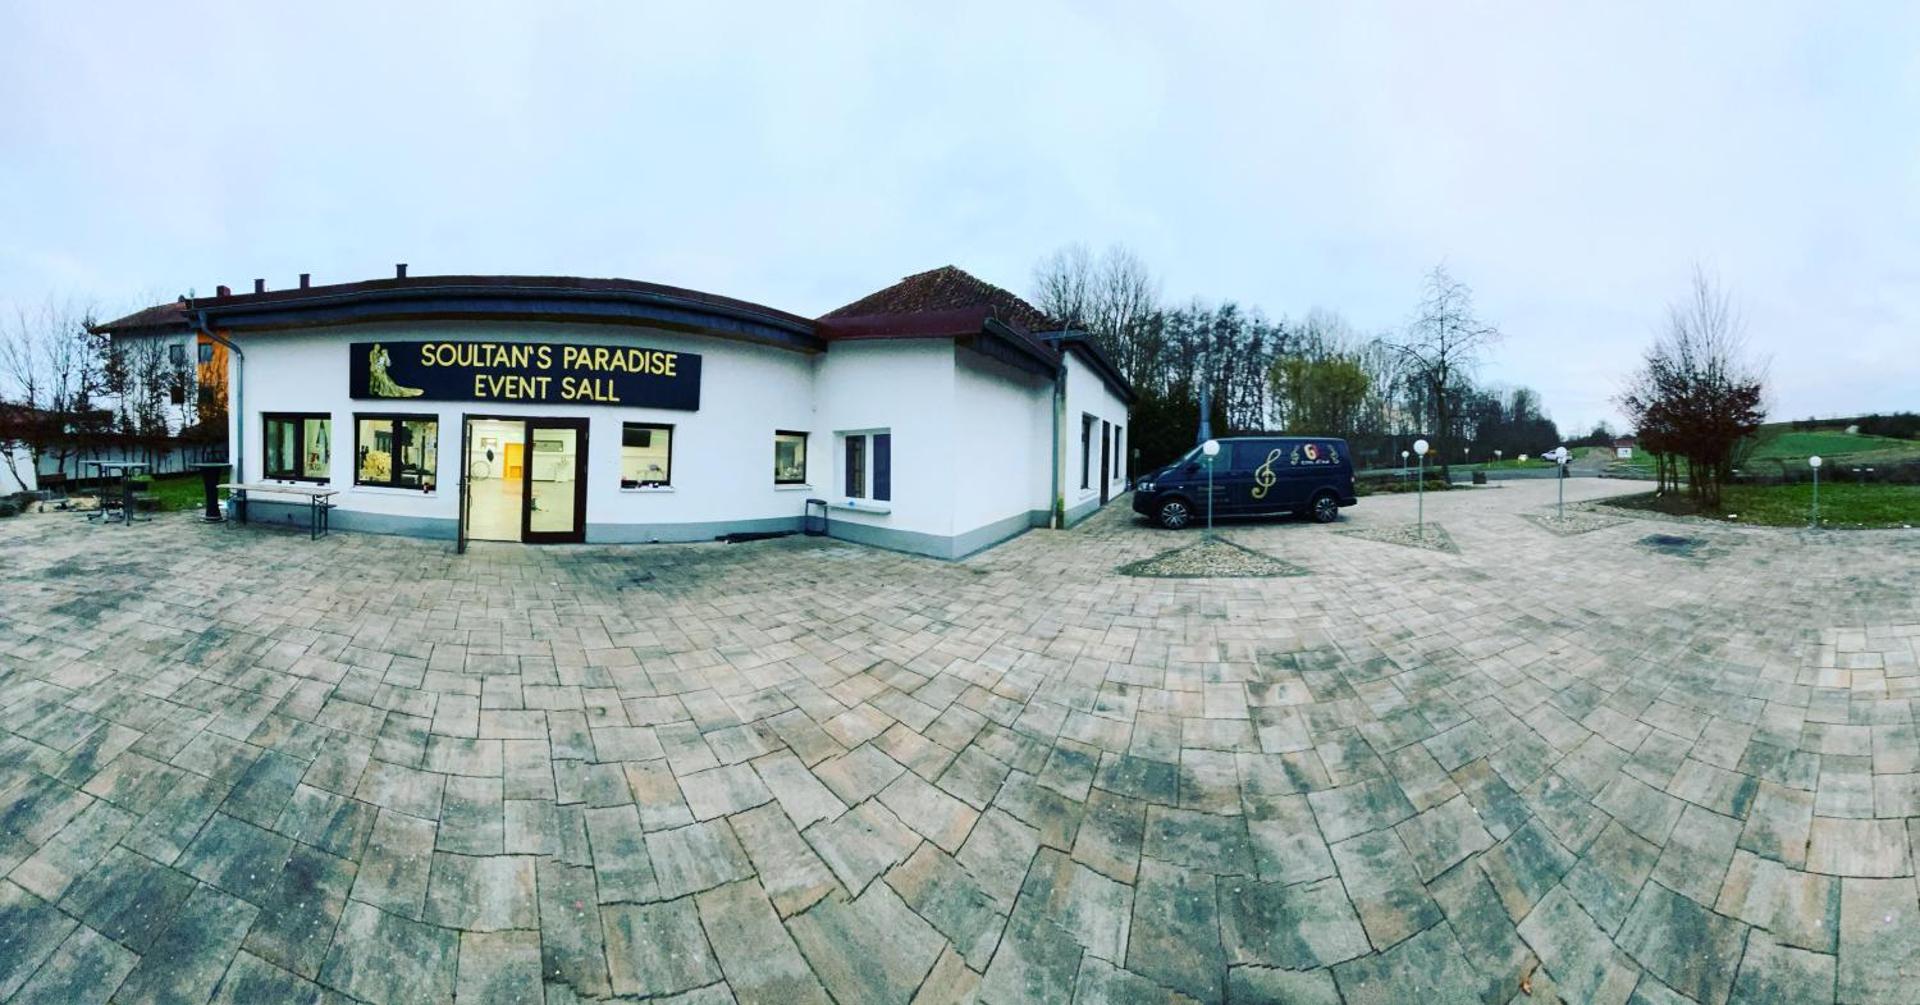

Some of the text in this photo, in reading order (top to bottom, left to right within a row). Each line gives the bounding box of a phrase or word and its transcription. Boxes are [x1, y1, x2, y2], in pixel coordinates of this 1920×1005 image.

[421, 343, 678, 376] SOULTAN'S PARADISE
[474, 374, 621, 402] EVENT SALL
